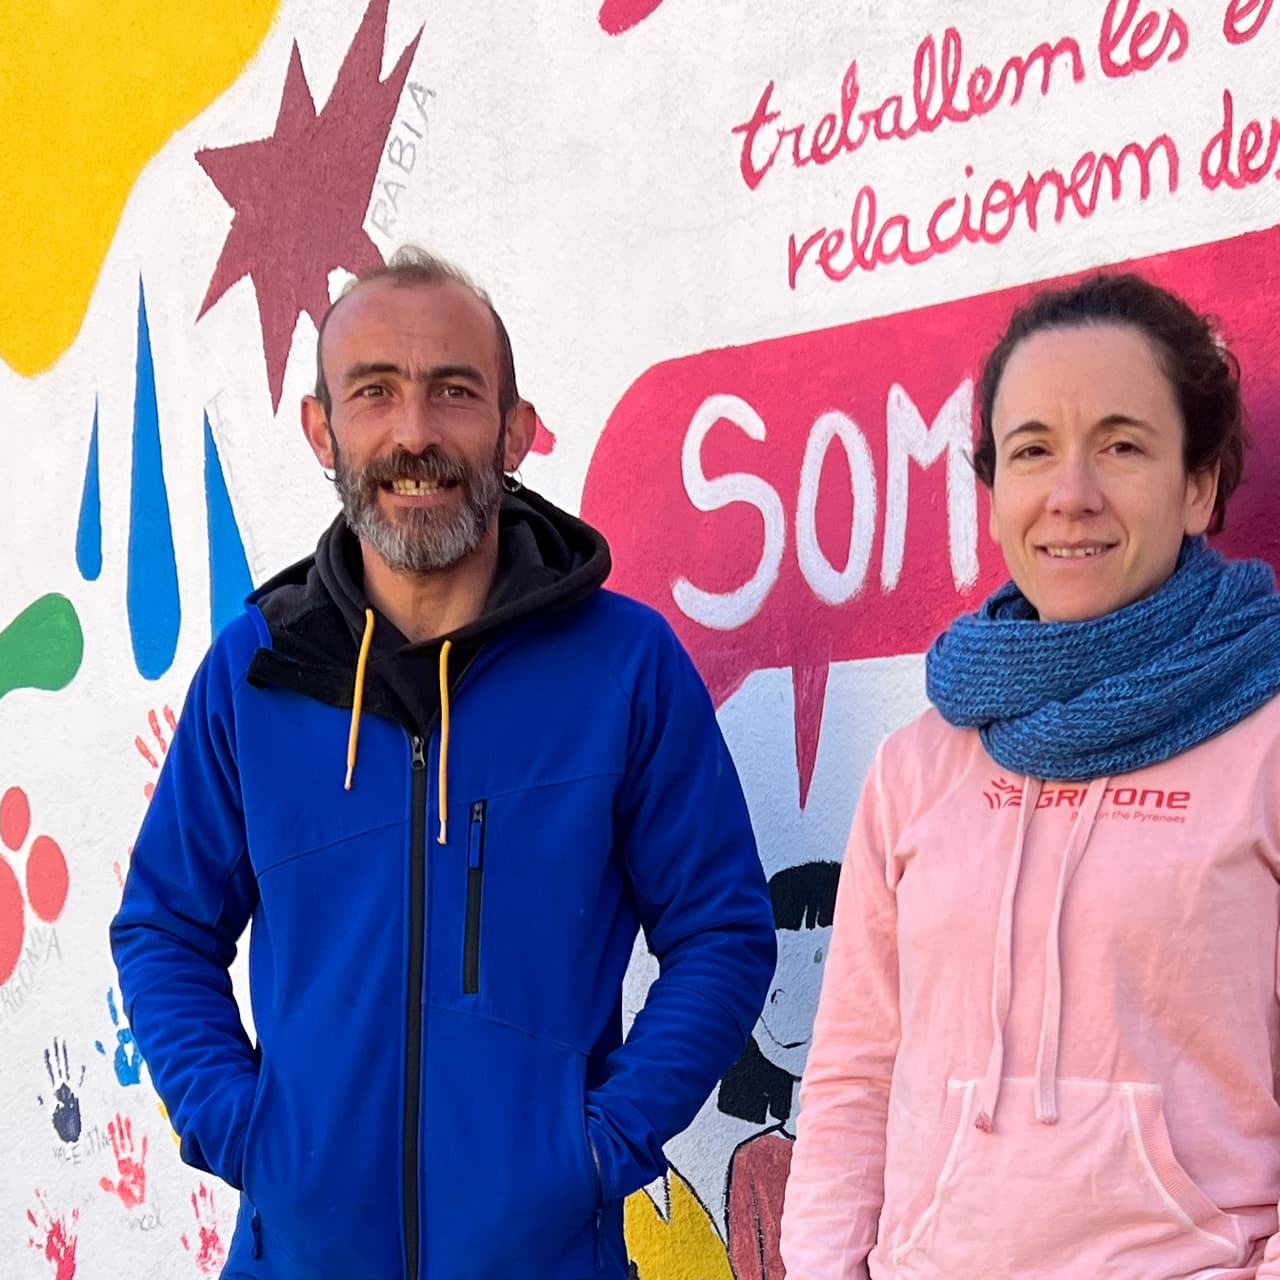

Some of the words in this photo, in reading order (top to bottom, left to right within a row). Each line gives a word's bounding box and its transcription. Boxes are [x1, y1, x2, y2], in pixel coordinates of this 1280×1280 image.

[732, 28, 1084, 190] treballem
[1099, 0, 1189, 78] les
[788, 134, 1180, 289] relacionem
[672, 380, 979, 630] SOM
